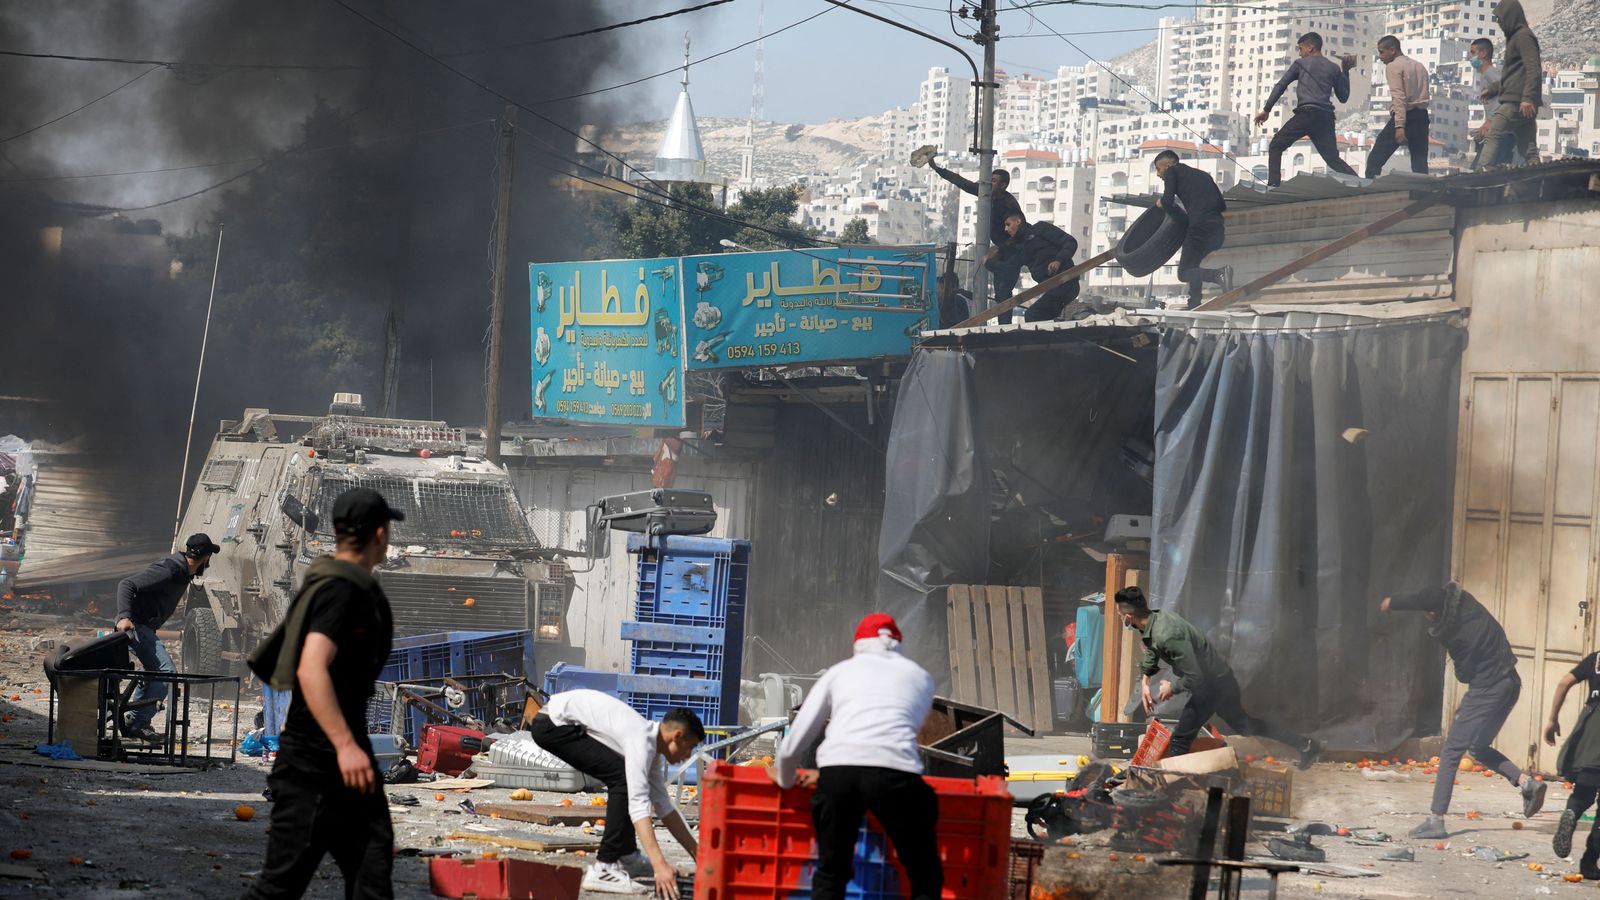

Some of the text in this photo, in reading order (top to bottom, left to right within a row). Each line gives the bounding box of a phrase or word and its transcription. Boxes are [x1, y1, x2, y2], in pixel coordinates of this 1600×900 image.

[556, 267, 650, 343] فطاير
[754, 313, 786, 338] تأجير
[800, 315, 838, 335] صيانة
[851, 316, 873, 333] بيع
[727, 342, 801, 359] 0594 159 413
[562, 352, 585, 392] تأجير
[593, 360, 620, 394] صيانة
[629, 369, 646, 395] بيع
